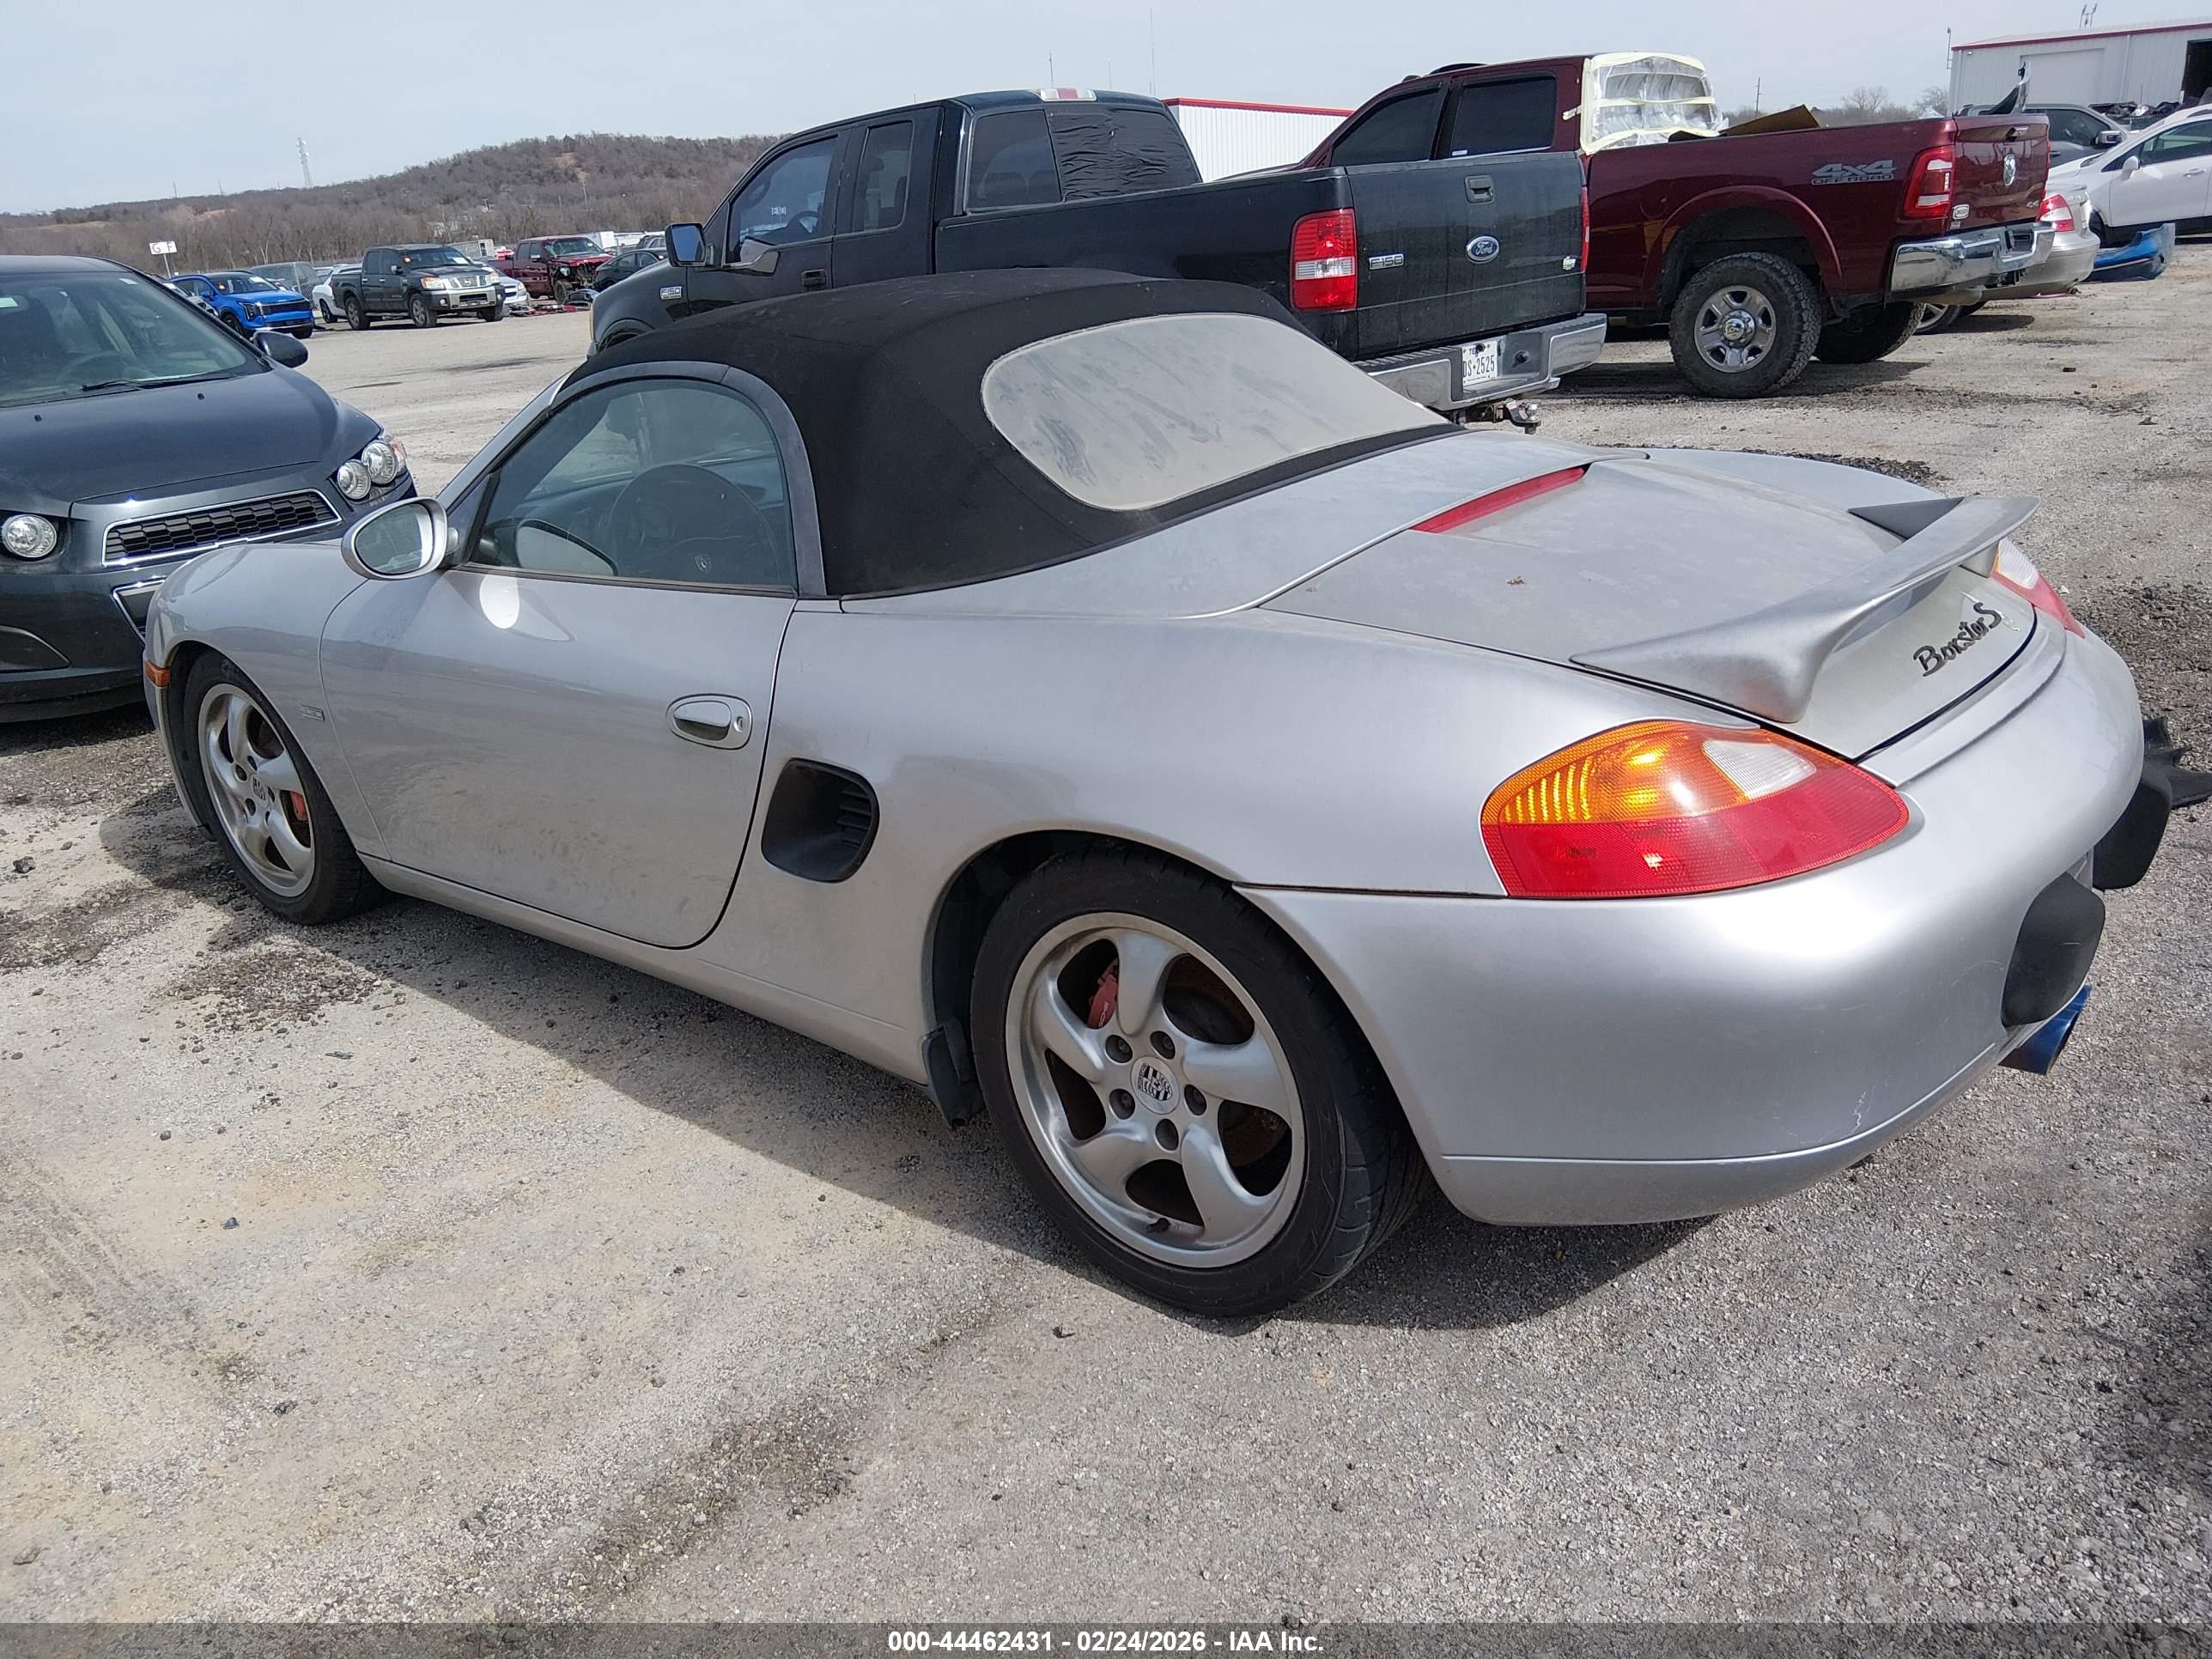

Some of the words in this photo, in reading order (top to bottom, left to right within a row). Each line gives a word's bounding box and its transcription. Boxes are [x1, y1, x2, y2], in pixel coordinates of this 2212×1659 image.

[1847, 173, 1893, 182] ROAD
[152, 243, 161, 253] G
[1475, 240, 1493, 255] Ford
[1912, 617, 1990, 678] Boxster
